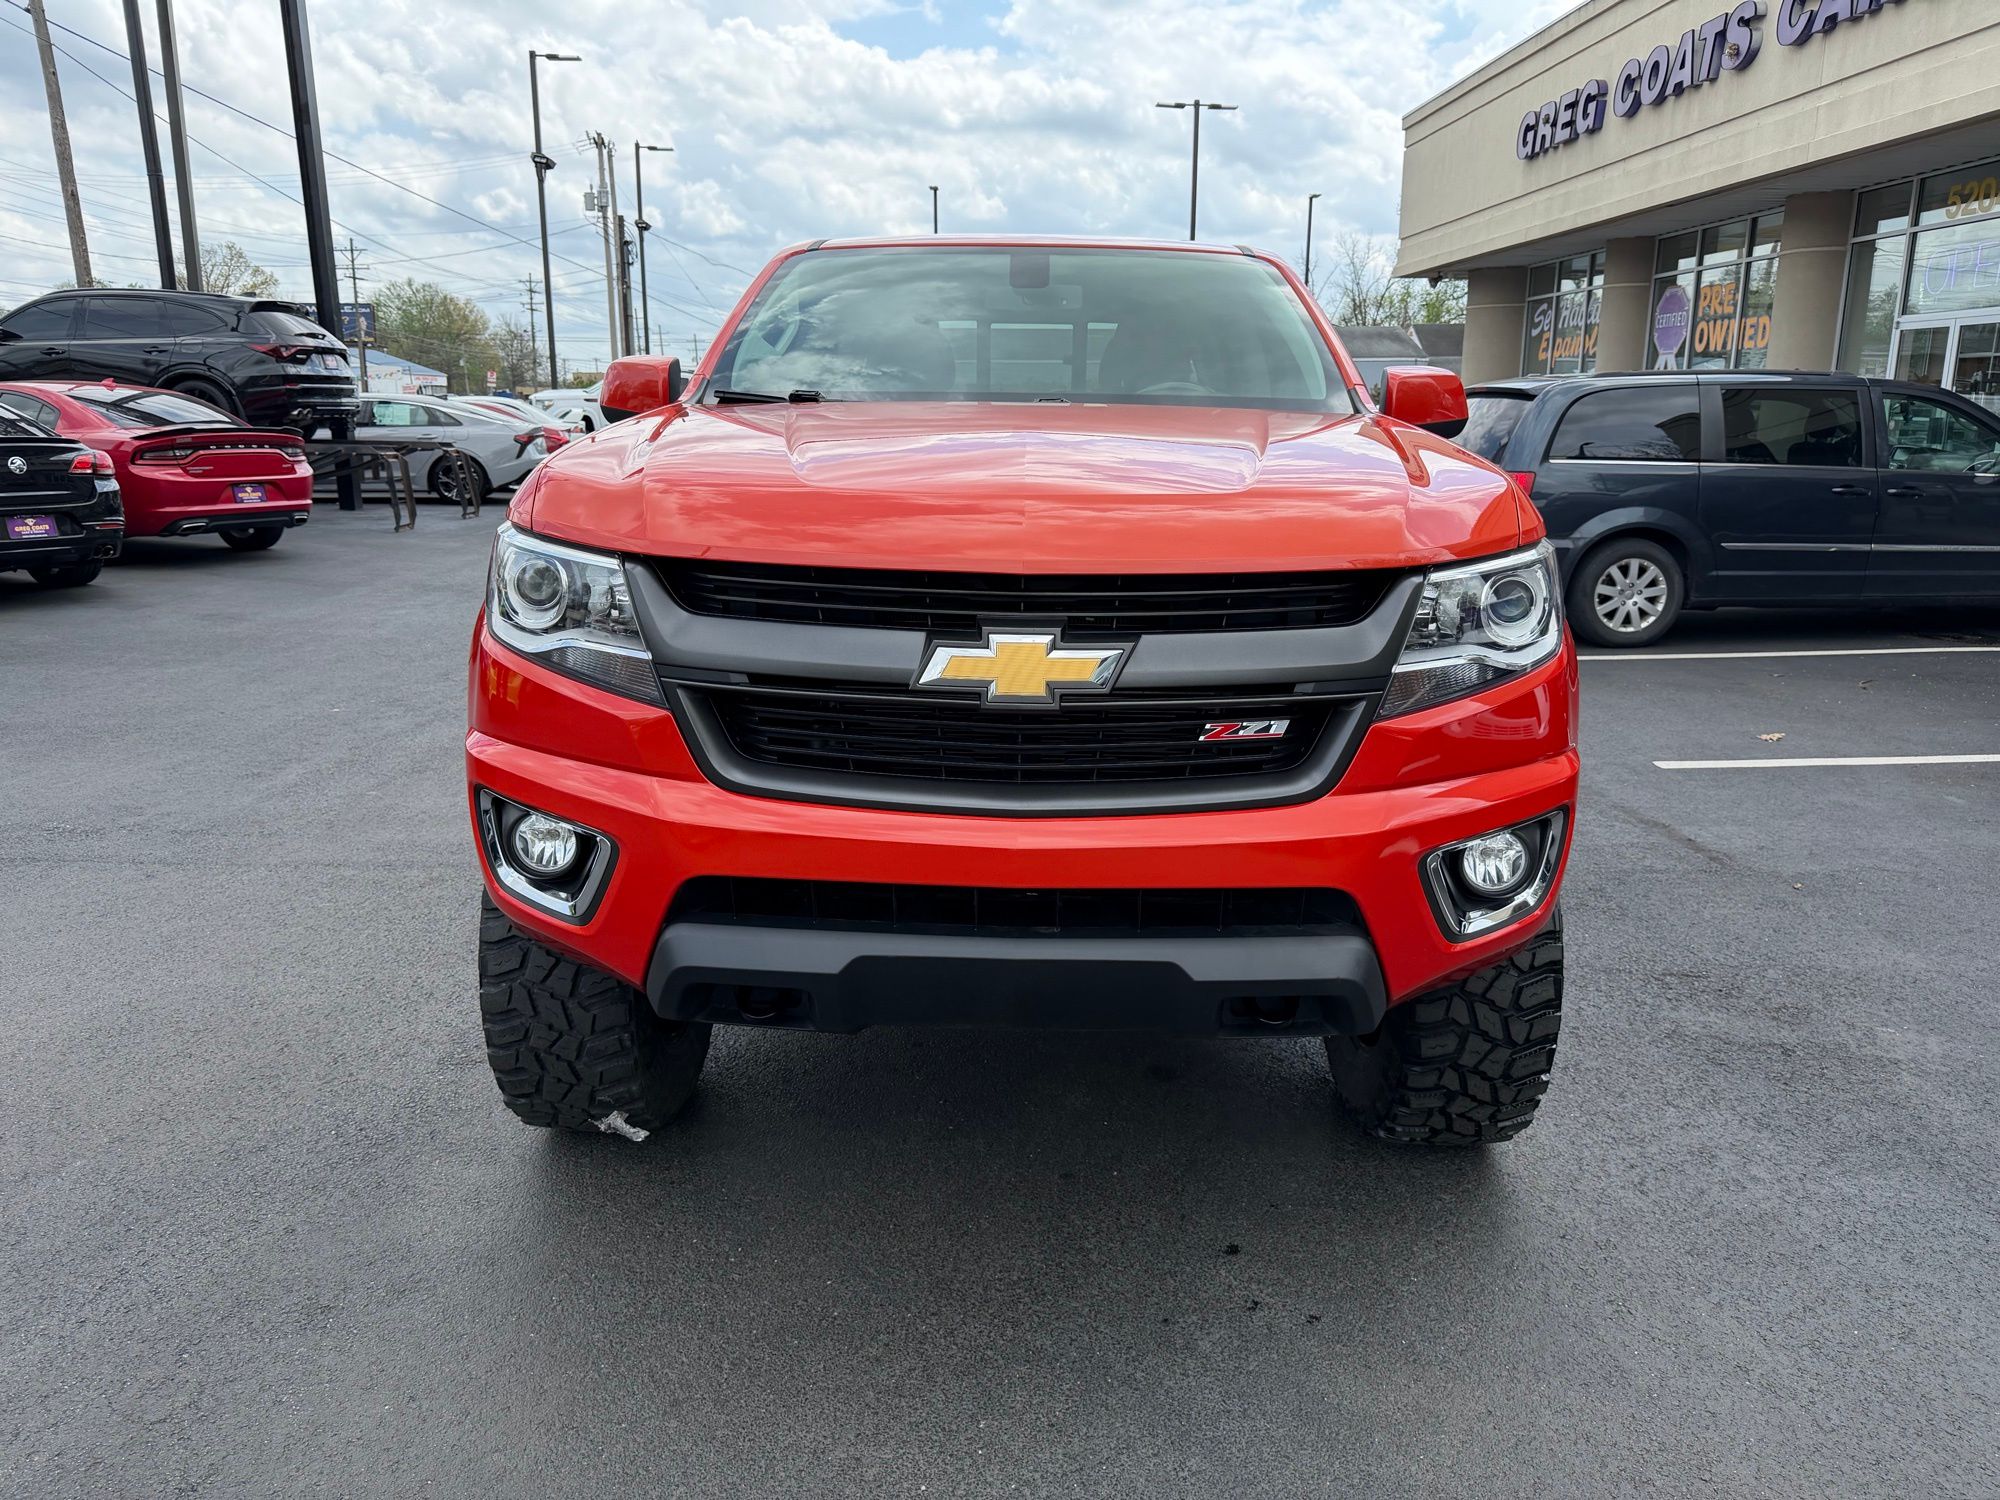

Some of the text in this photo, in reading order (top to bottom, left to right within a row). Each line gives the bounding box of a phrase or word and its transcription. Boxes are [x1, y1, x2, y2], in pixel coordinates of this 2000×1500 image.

[1516, 0, 1893, 160] GREG COATS CA
[1945, 176, 2000, 219] 520
[1925, 241, 2000, 295] OPE
[1531, 303, 1552, 337] Se
[1656, 311, 1687, 328] CERTIFIED
[1694, 315, 1770, 353] OWNED
[1199, 719, 1291, 741] Z71
